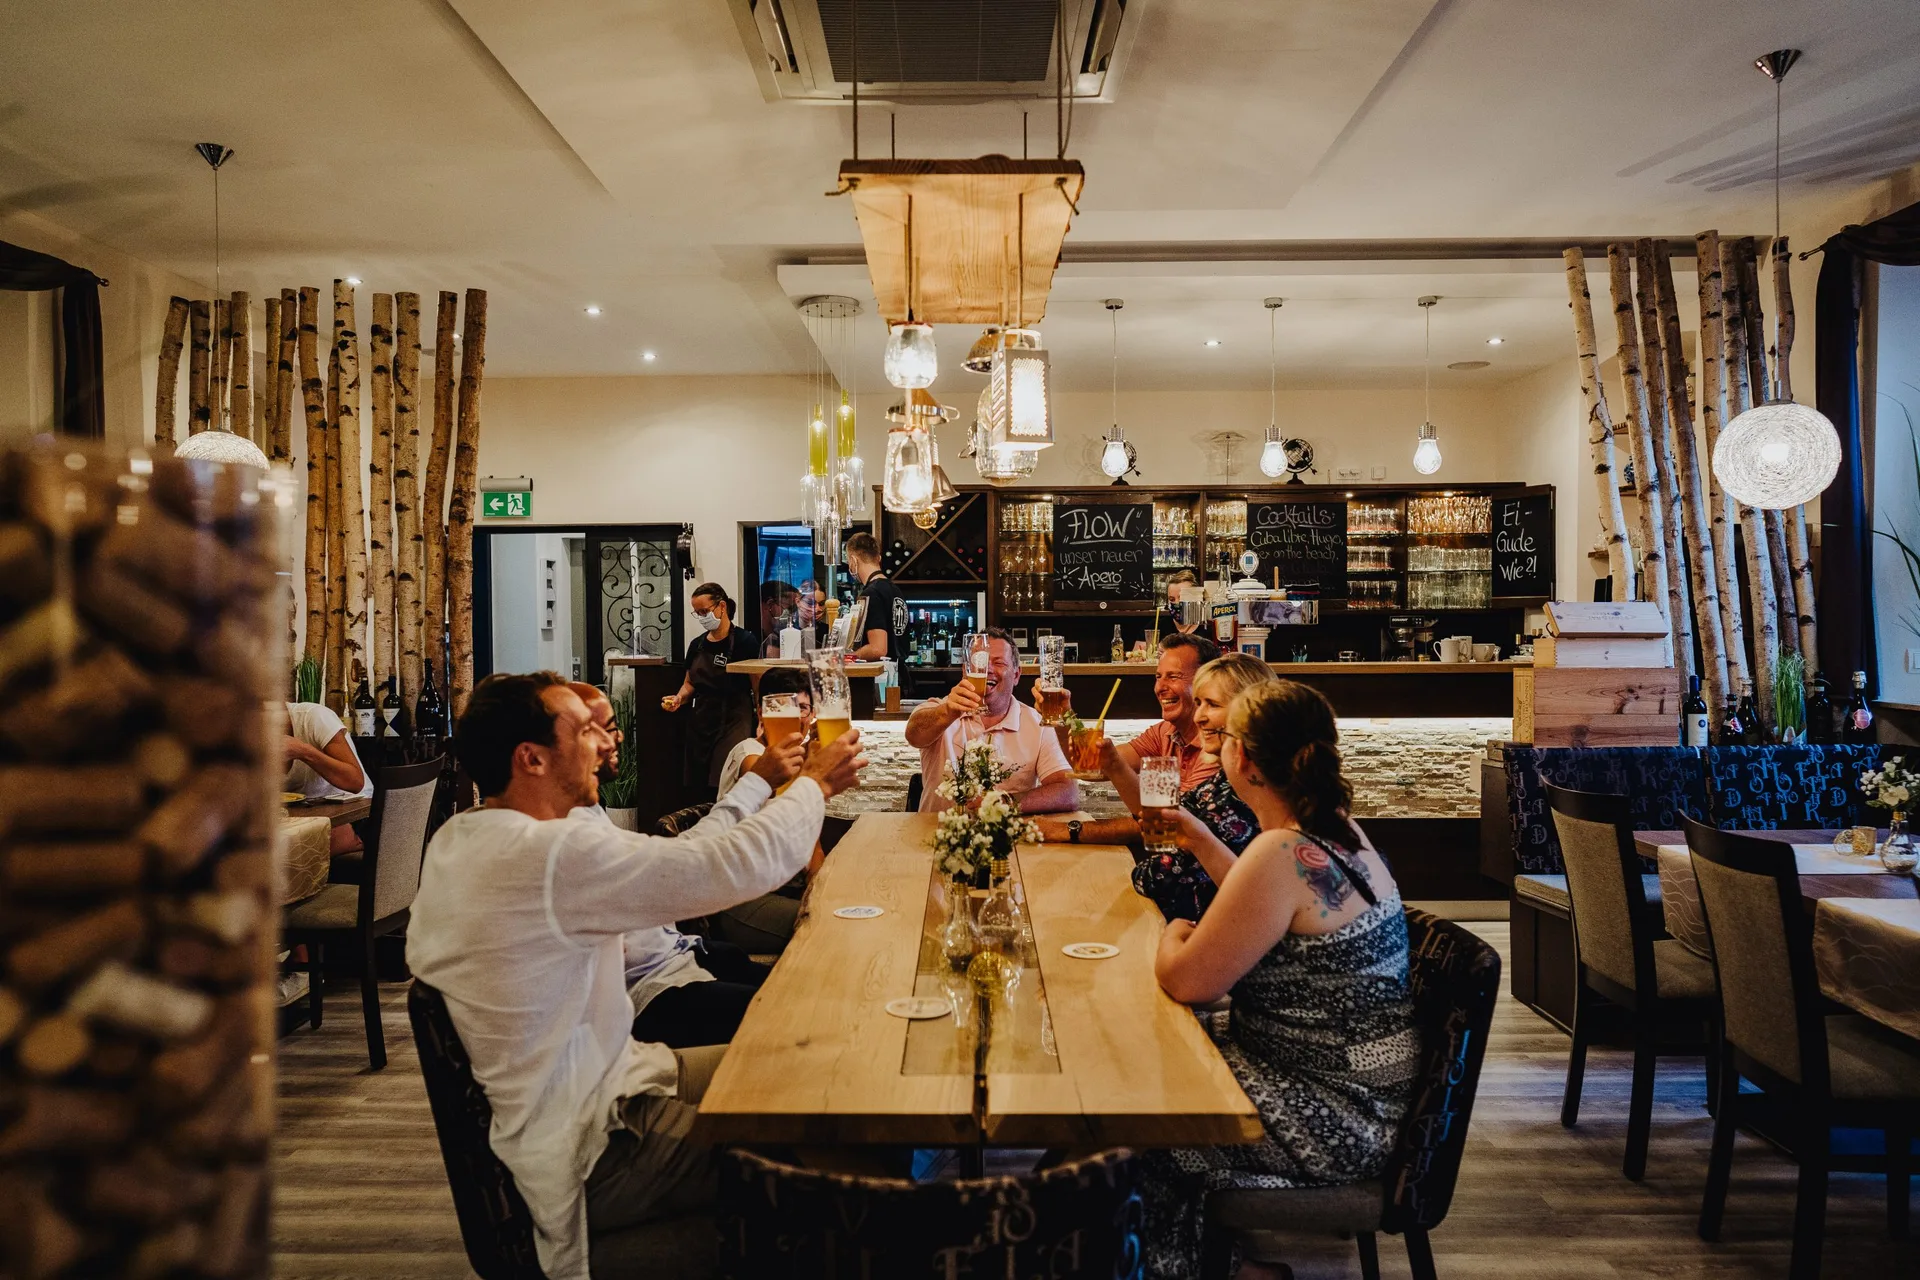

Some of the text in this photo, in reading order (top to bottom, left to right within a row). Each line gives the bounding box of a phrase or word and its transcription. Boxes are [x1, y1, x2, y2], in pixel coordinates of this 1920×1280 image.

[1502, 501, 1521, 526] Ei
[1250, 531, 1282, 547] Cuba
[1496, 528, 1536, 552] Gude
[1059, 549, 1143, 566] unser neuer
[1273, 550, 1285, 559] on
[1285, 545, 1303, 560] the
[1213, 605, 1236, 617] APEROL
